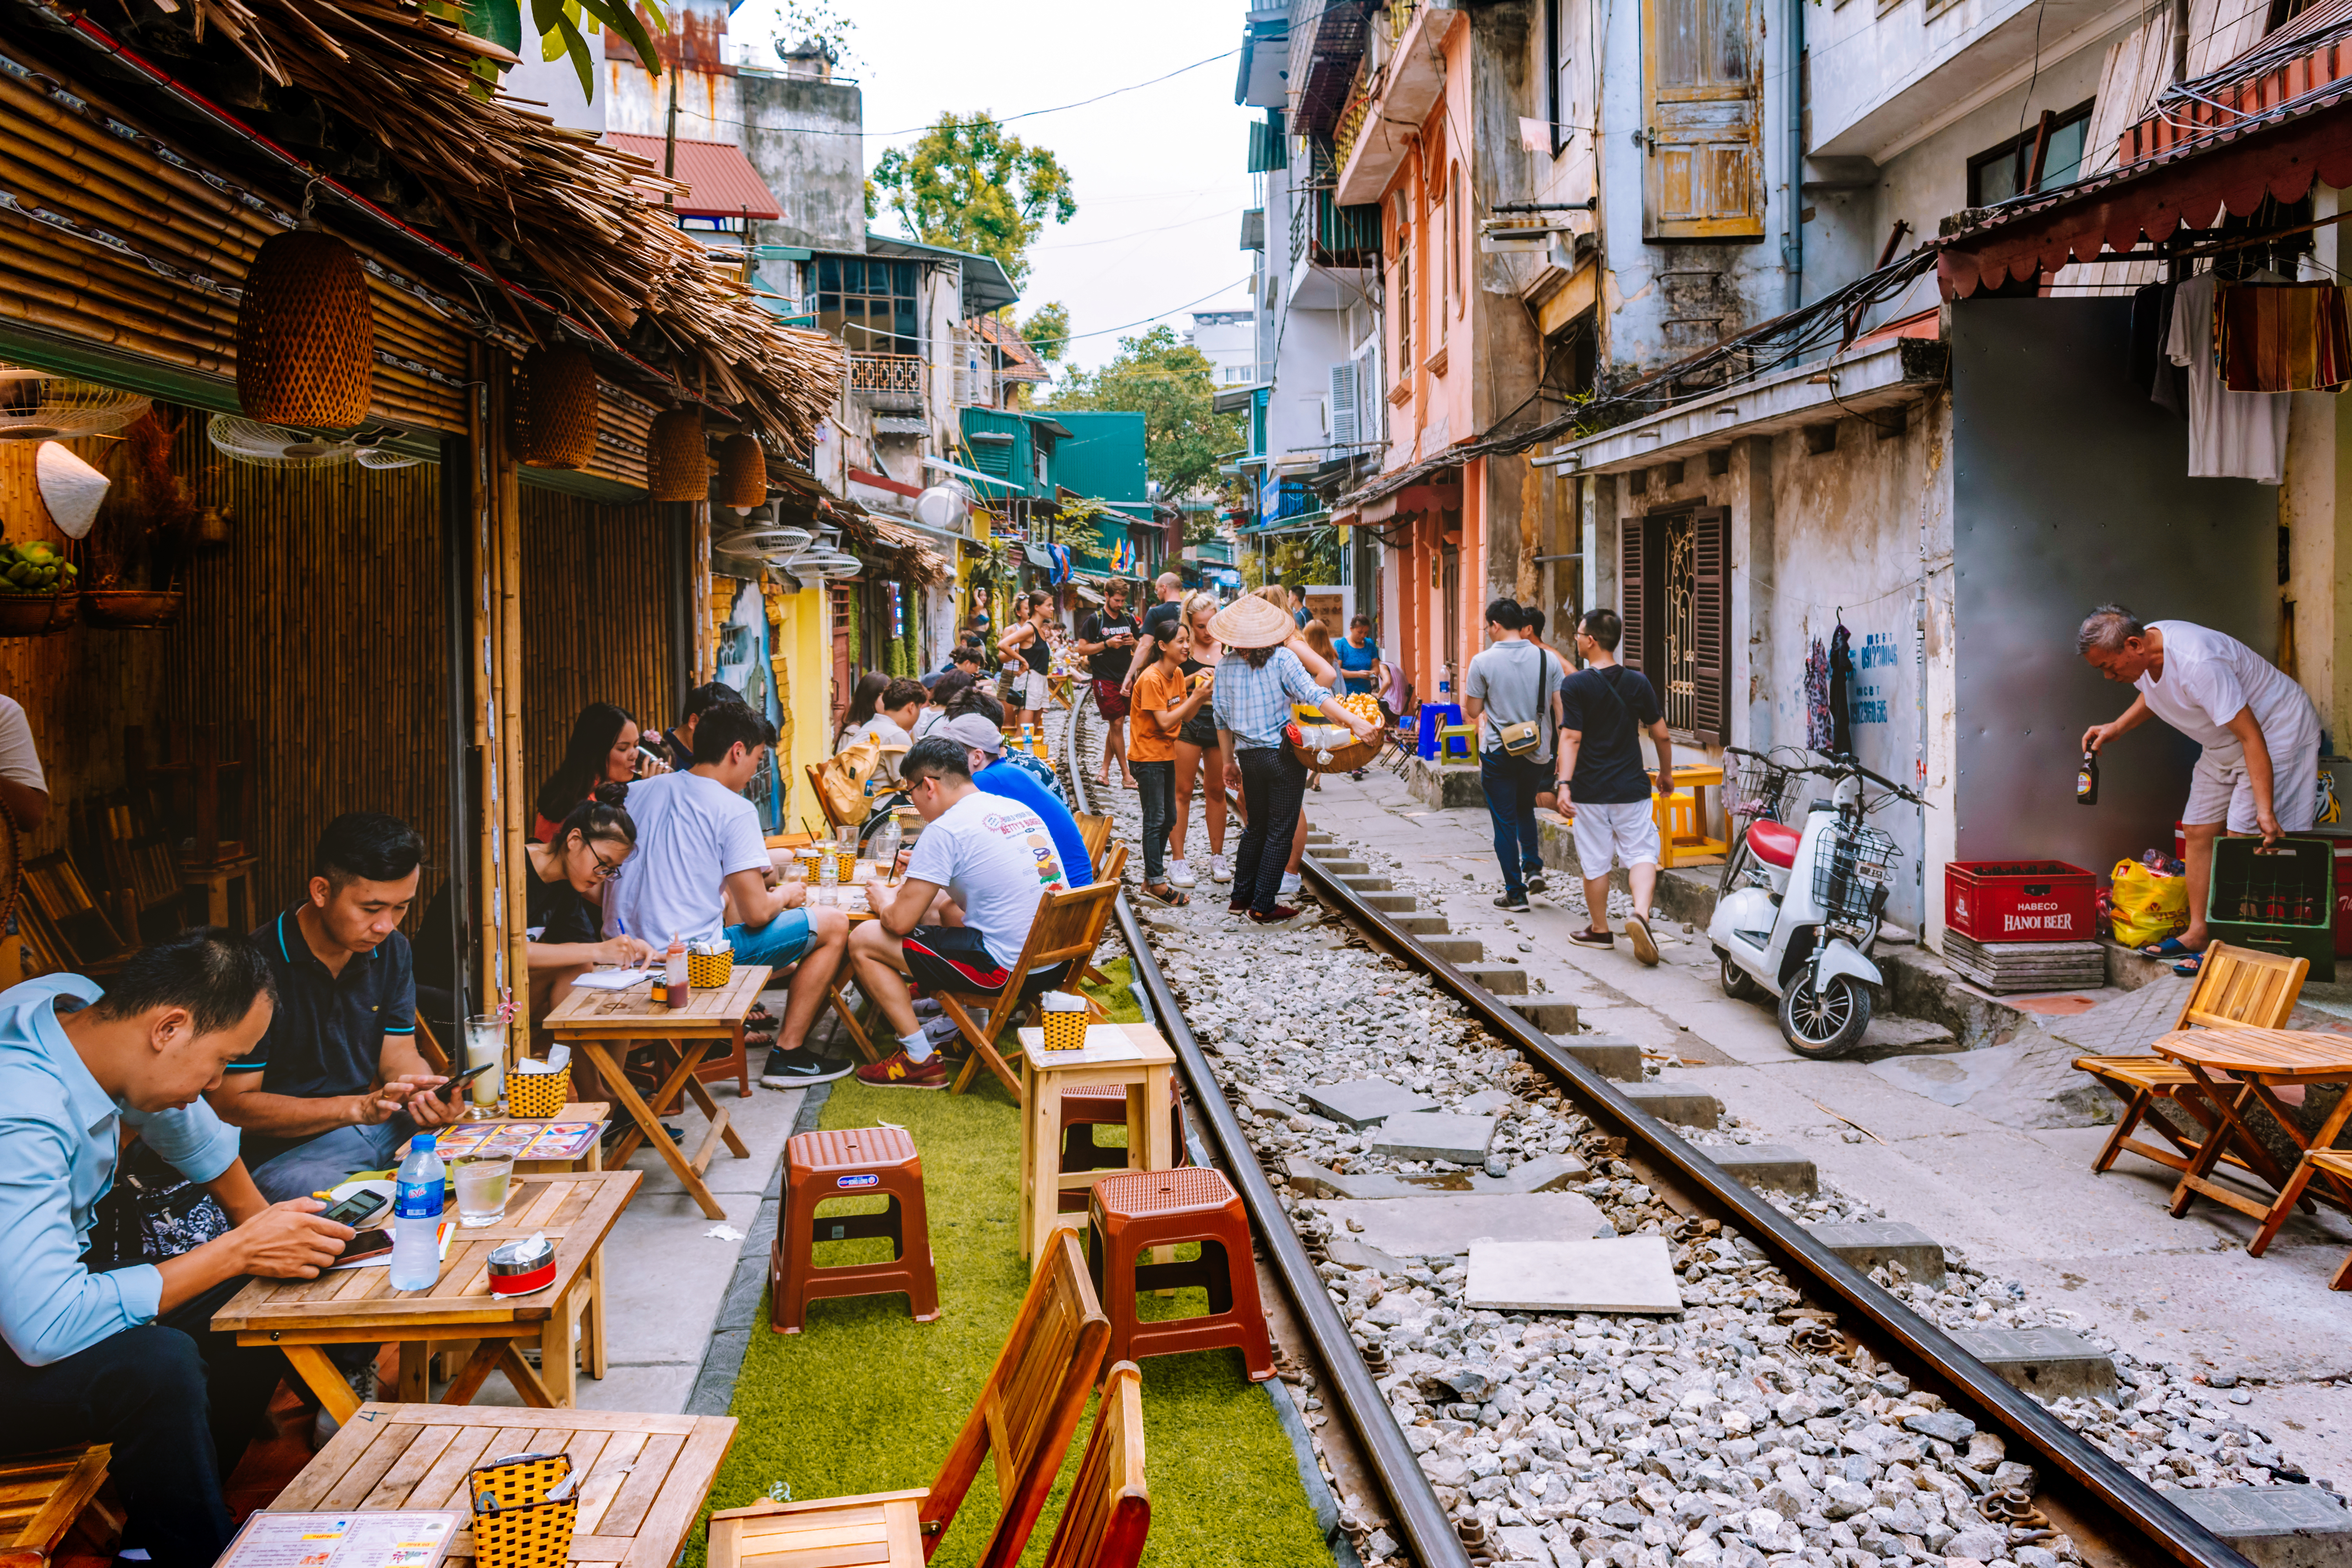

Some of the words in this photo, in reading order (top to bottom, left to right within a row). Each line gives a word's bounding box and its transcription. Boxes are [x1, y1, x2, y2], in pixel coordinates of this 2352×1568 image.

[2018, 902, 2058, 911] HABECO
[2004, 914, 2042, 932] HANOI
[2043, 913, 2073, 930] BEER
